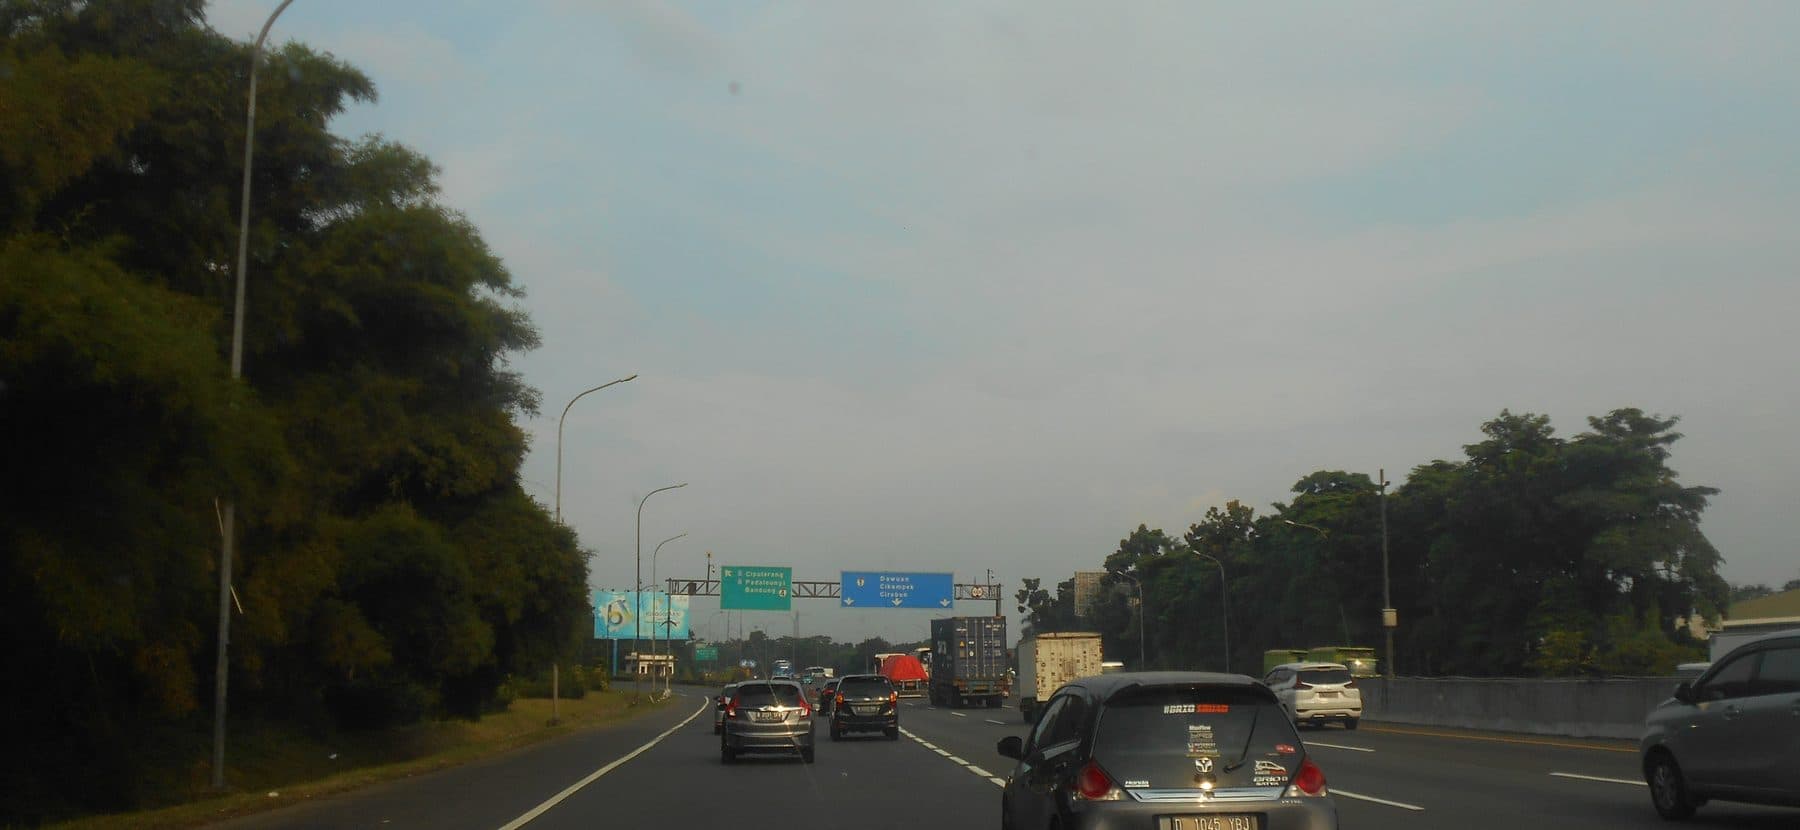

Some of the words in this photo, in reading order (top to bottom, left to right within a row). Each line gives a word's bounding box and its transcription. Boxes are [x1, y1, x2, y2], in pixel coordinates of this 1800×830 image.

[744, 586, 776, 595] Bandung
[1175, 818, 1182, 830] D
[1195, 818, 1221, 830] 1045
[1228, 817, 1250, 830] YBJ
